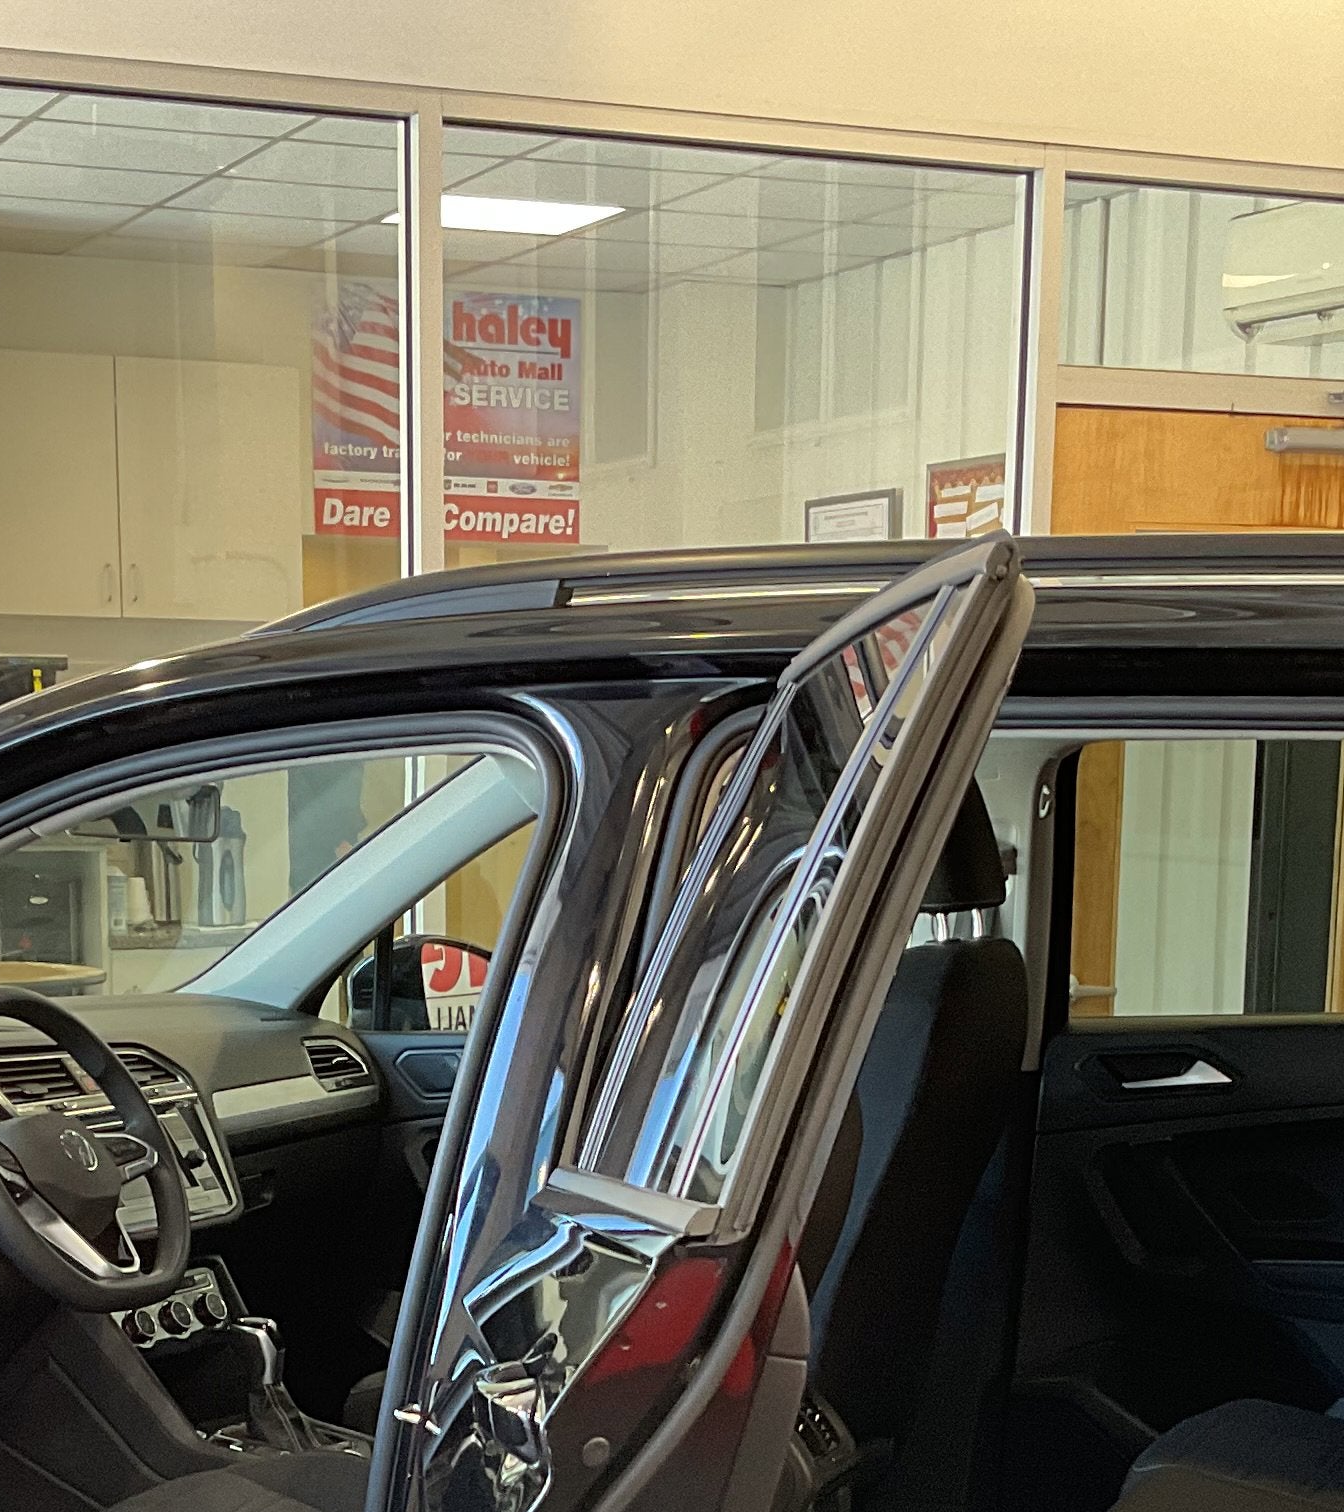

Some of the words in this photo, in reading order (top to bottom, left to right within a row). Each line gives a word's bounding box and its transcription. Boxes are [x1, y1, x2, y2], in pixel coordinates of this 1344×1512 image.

[452, 301, 572, 359] haley
[463, 359, 510, 379] Auto
[518, 361, 563, 381] Mall
[454, 383, 570, 412] SERVICE
[457, 430, 542, 447] technicians
[547, 437, 570, 448] are
[323, 442, 378, 460] factory
[513, 453, 570, 467] vehicle!
[323, 498, 391, 528] Dare
[443, 503, 575, 539] Compare!
